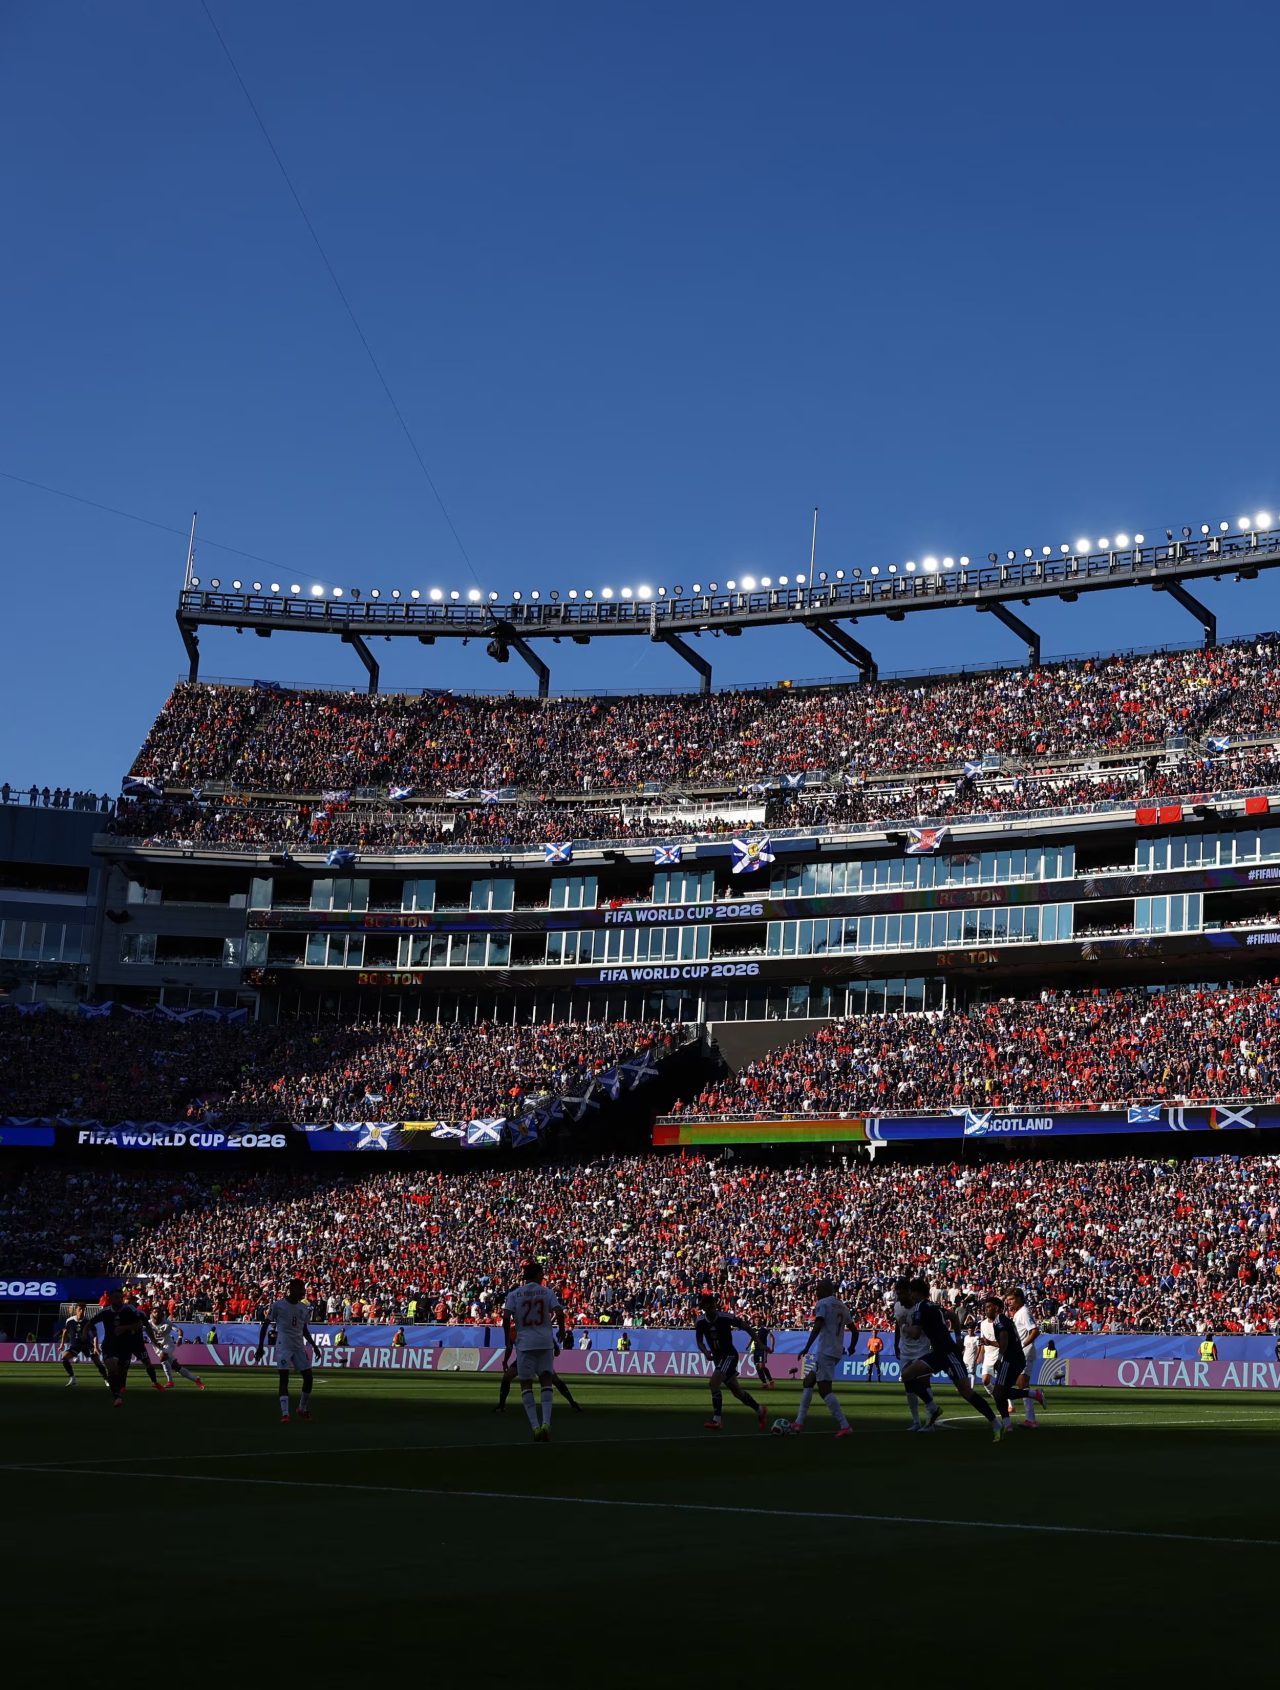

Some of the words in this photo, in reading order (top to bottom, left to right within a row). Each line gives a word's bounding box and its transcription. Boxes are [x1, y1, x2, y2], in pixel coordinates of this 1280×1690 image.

[604, 910, 634, 923] FIFA
[636, 908, 684, 922] WORLD
[687, 906, 713, 919] CUP
[715, 903, 764, 918] 2026
[600, 969, 628, 982] FIFA
[631, 967, 680, 981] WORLD
[682, 965, 709, 978] CUP
[711, 963, 760, 977] 2026
[78, 1130, 117, 1146] FIFA
[122, 1132, 185, 1147] WORLD
[189, 1133, 225, 1147] CUP
[227, 1134, 287, 1148] 2026
[0, 1281, 57, 1297] 2026
[522, 1300, 545, 1326] 23
[228, 1345, 278, 1367] WORL
[359, 1348, 433, 1369] AIRLINE
[585, 1350, 656, 1375] QATAR
[664, 1351, 757, 1377] AIRWYS
[1117, 1359, 1210, 1388] QATAR
